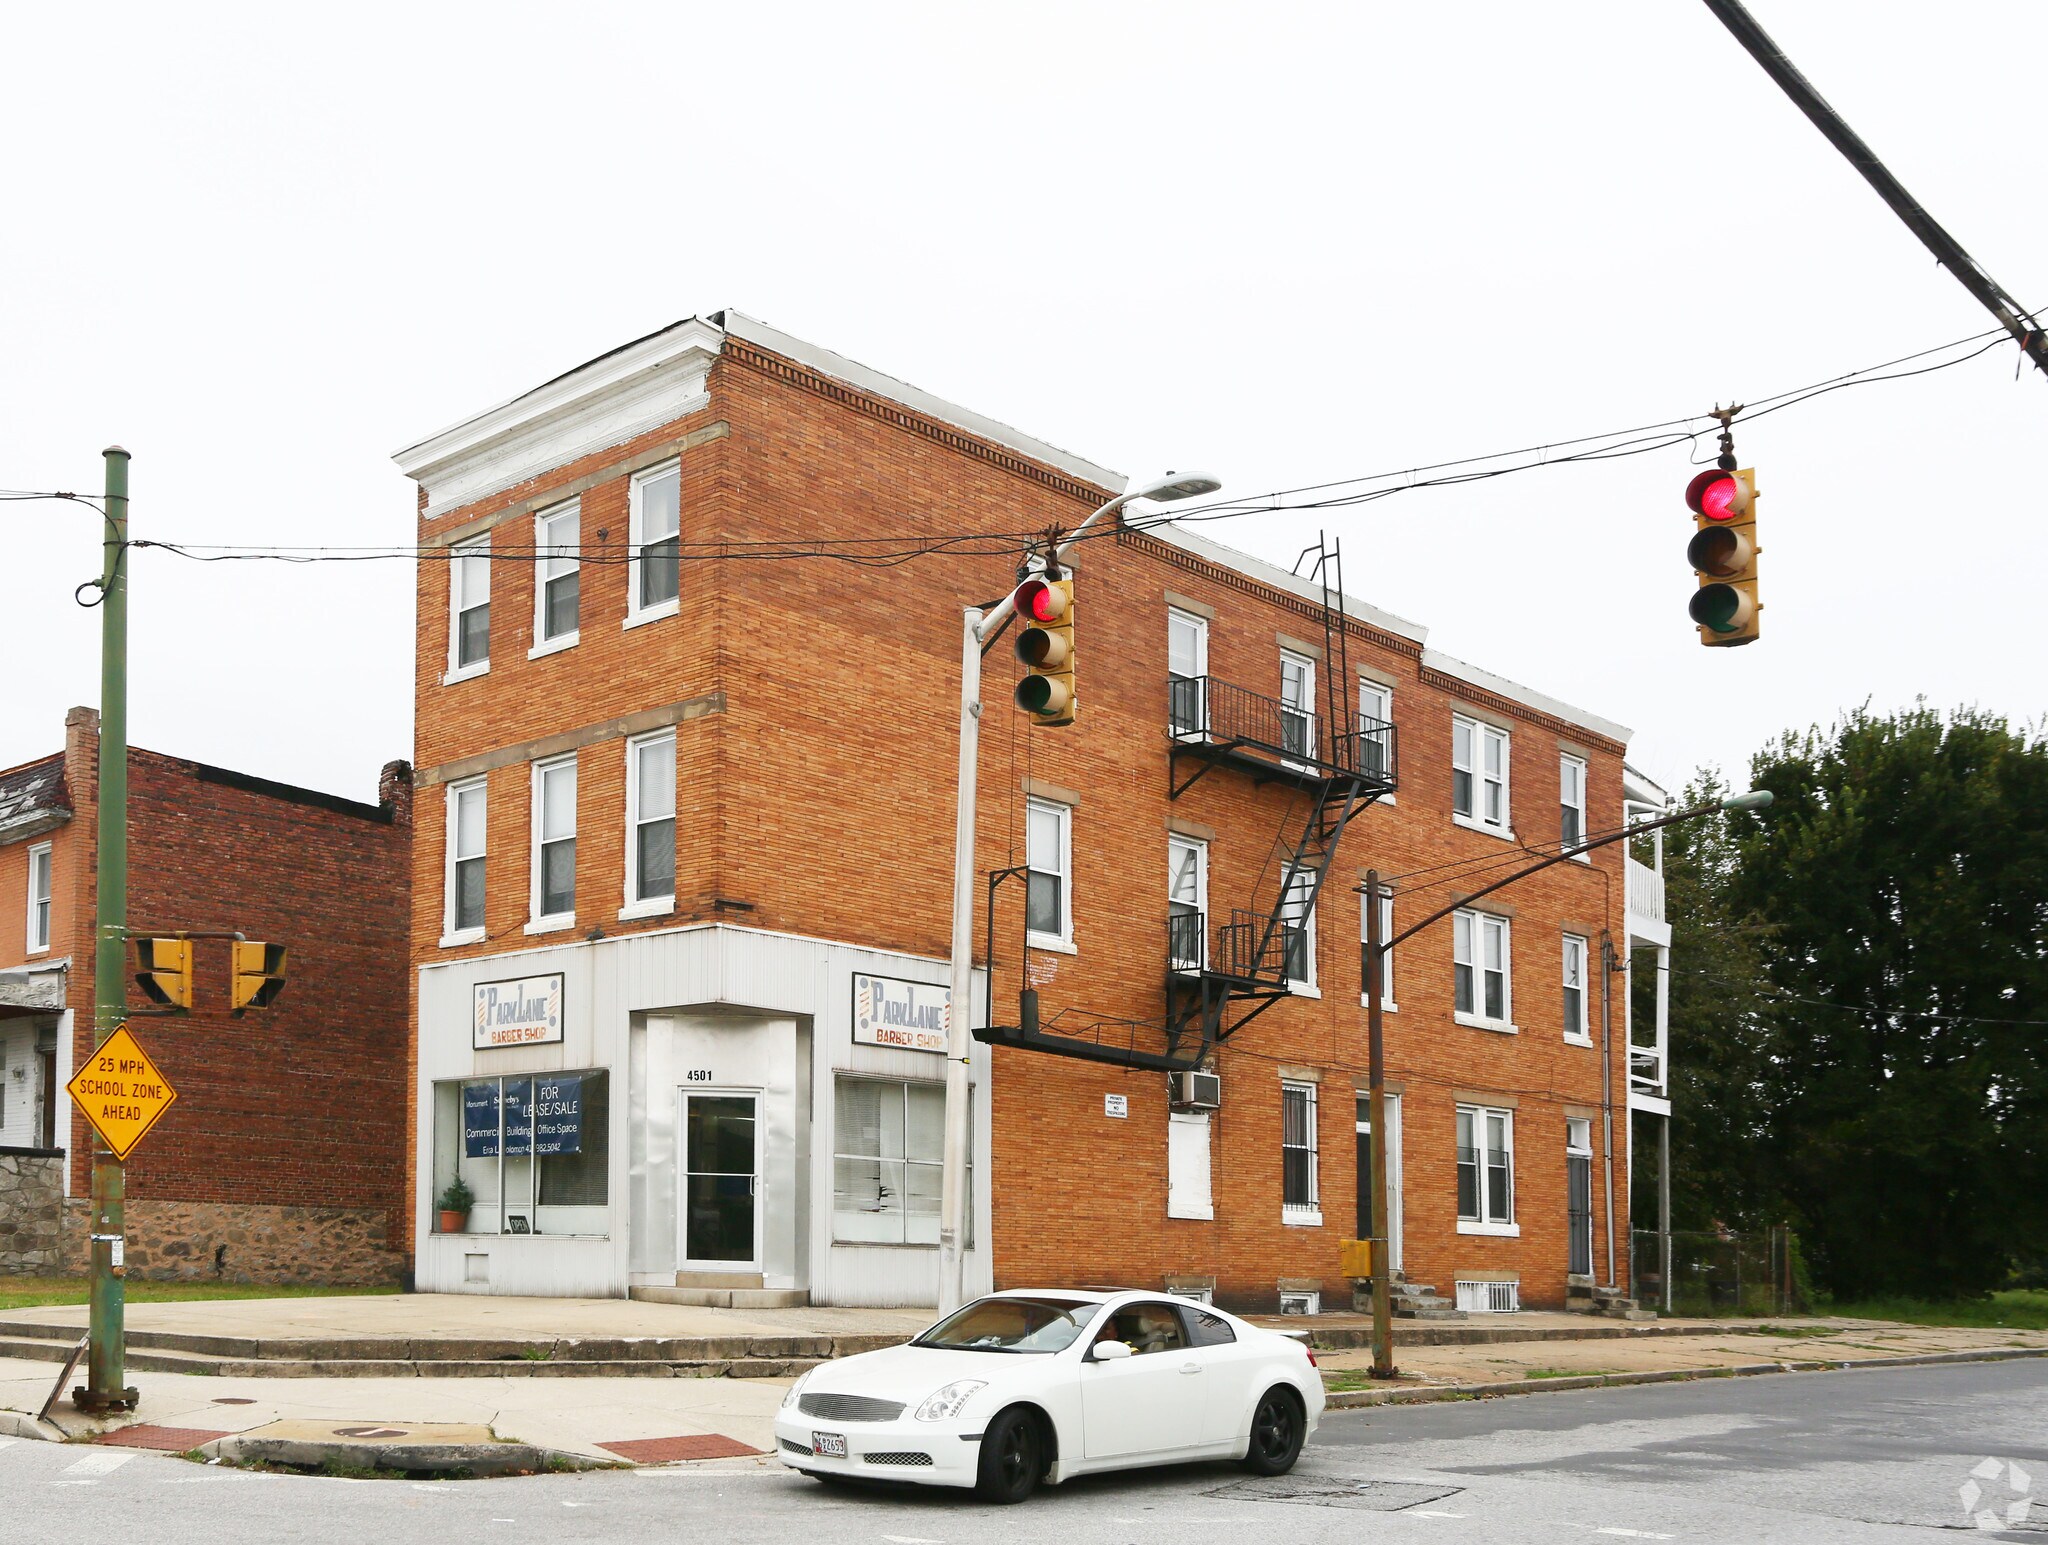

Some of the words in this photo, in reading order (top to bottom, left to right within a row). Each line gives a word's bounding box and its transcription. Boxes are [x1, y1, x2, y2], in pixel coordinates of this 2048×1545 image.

[491, 1029, 522, 1044] BARBER
[525, 1027, 547, 1041] SHOP
[876, 1028, 914, 1046] BARBER
[916, 1033, 943, 1049] SHOP
[99, 1057, 115, 1073] 25
[119, 1059, 145, 1076] MPH
[687, 1070, 712, 1081] 4501
[80, 1079, 127, 1097] SCHOOL
[132, 1083, 162, 1100] ZONE
[540, 1086, 559, 1100] FOR
[466, 1099, 489, 1109] Monument
[102, 1104, 141, 1121] AHEAD
[537, 1123, 556, 1135] Office
[556, 1122, 578, 1136] Space
[505, 1144, 525, 1154] olomon
